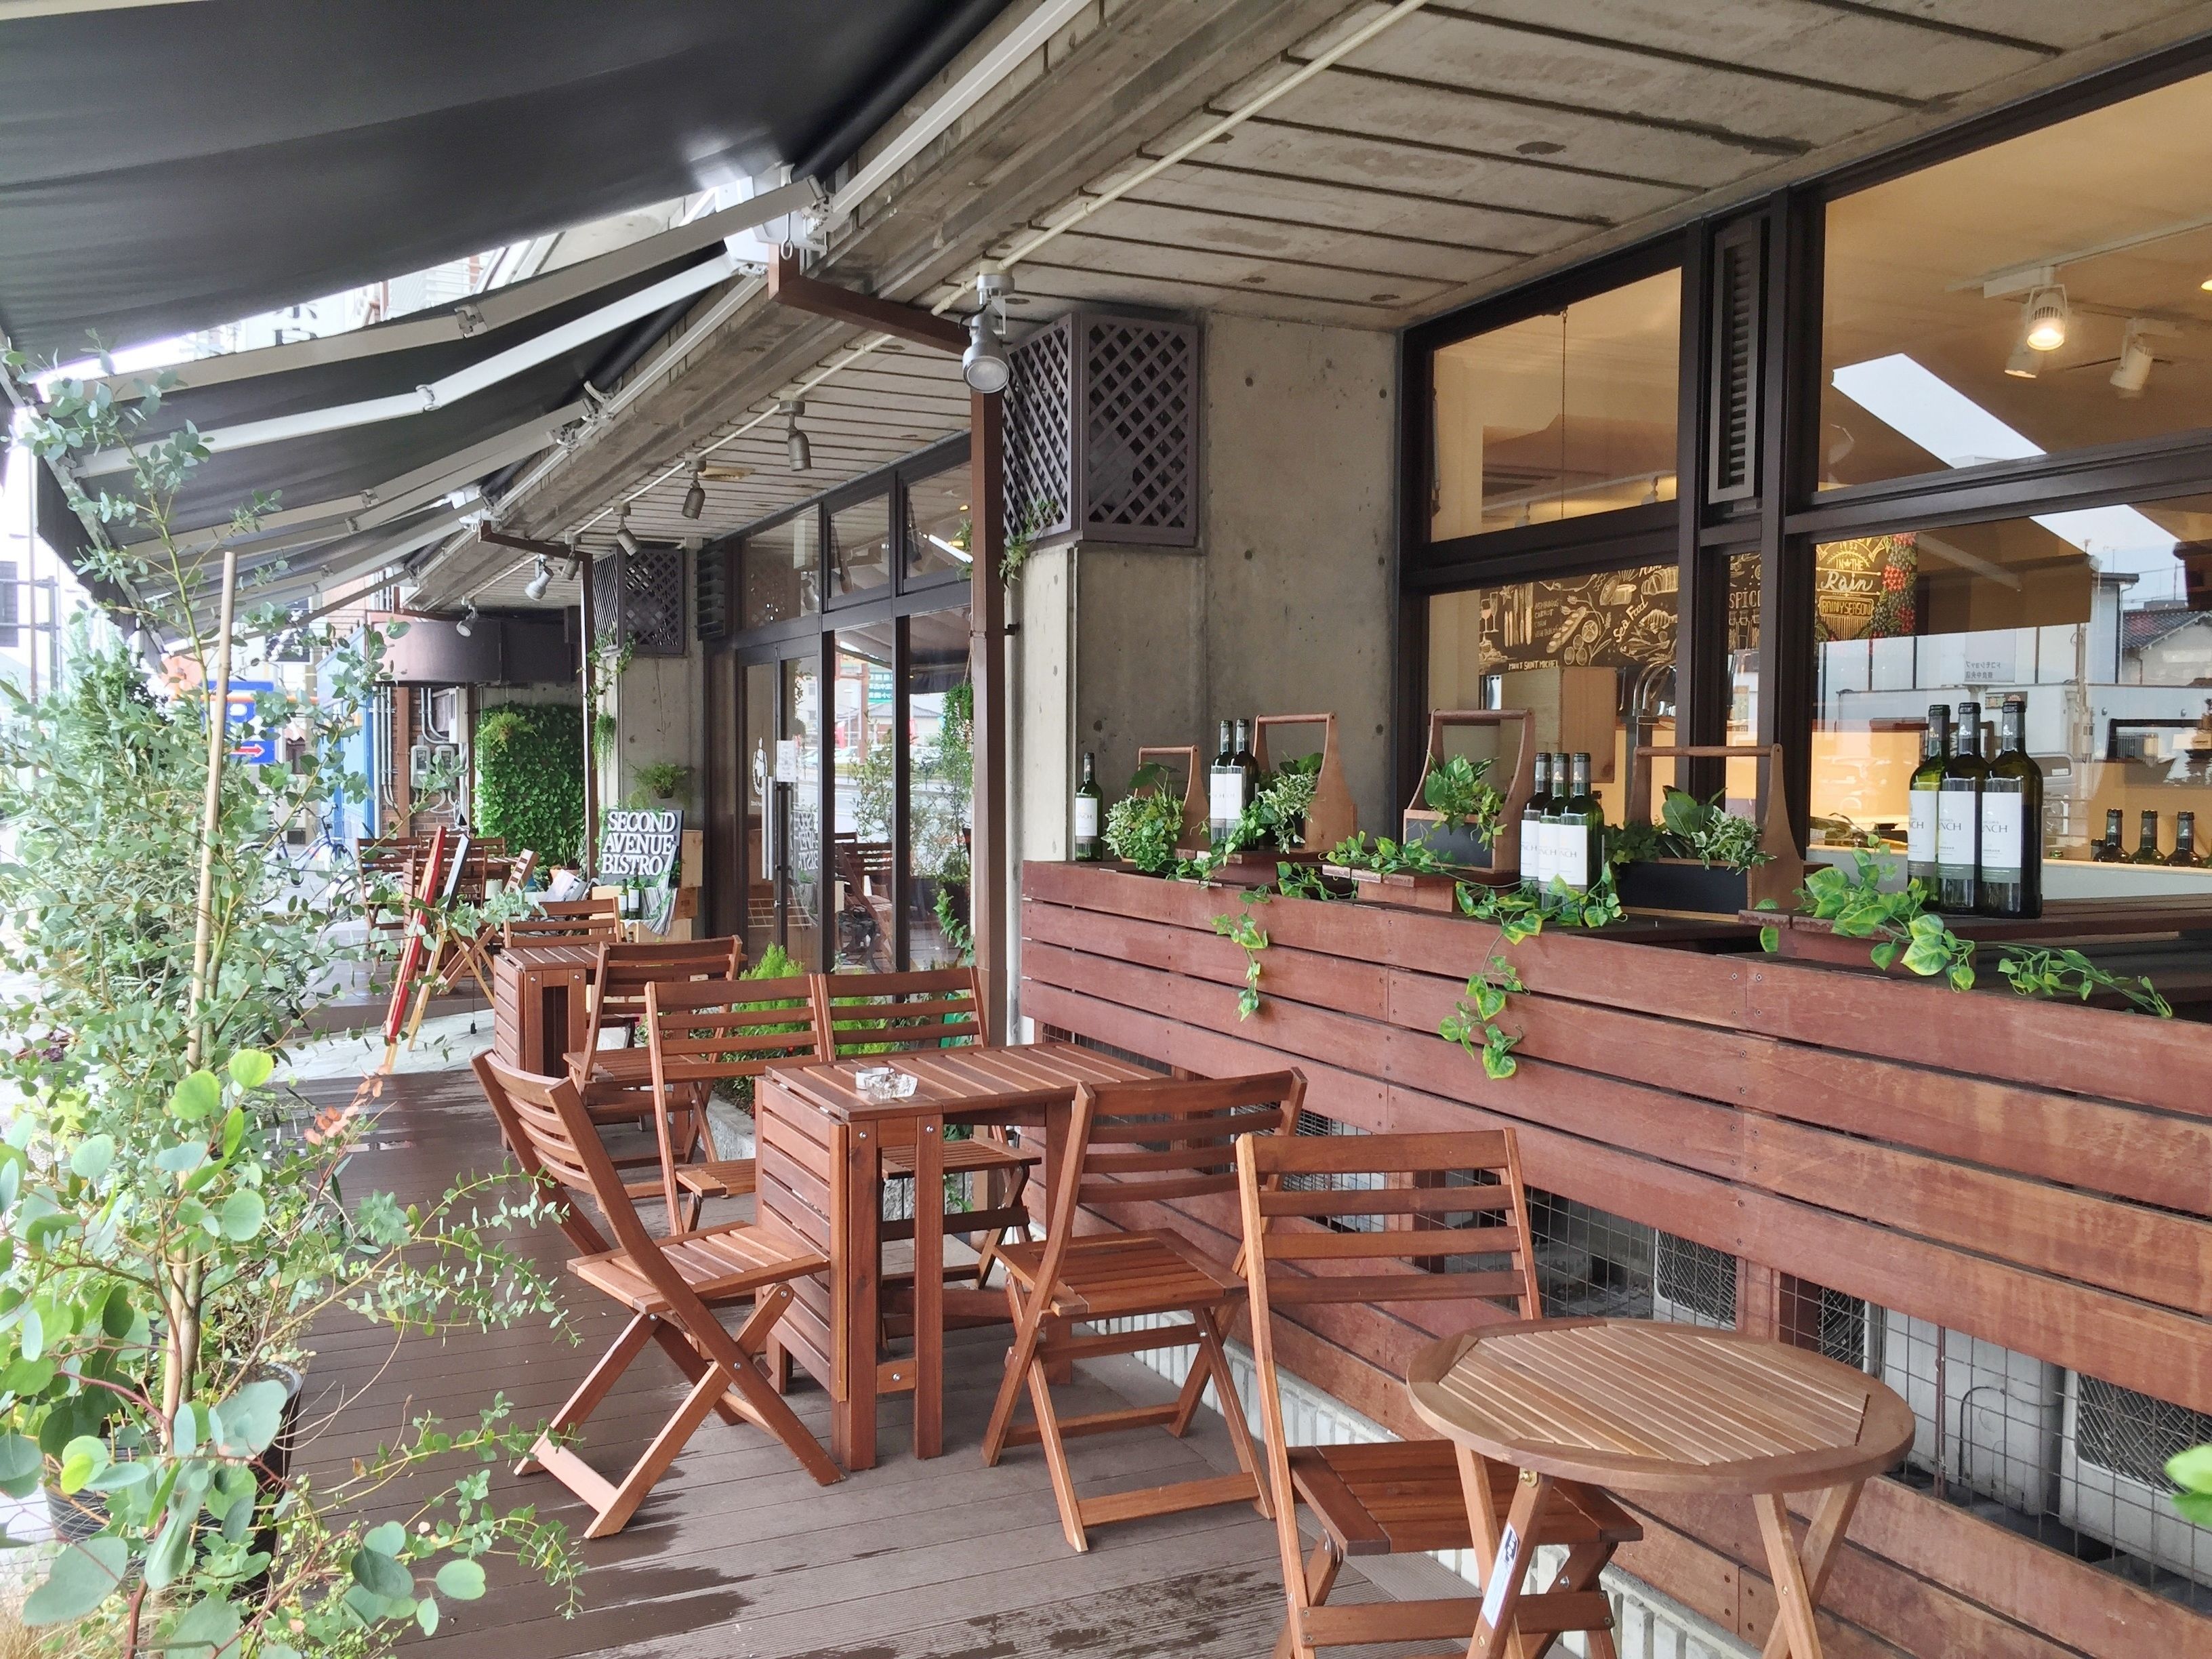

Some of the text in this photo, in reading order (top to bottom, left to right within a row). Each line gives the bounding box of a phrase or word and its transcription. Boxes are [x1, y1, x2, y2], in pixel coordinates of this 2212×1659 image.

[1836, 558, 1864, 571] IN THE
[1820, 571, 1873, 592] Rain
[1613, 594, 1649, 642] Sea Food
[607, 811, 676, 833] SECOND
[602, 832, 674, 855] AVENUE
[600, 853, 663, 876] BISTRO
